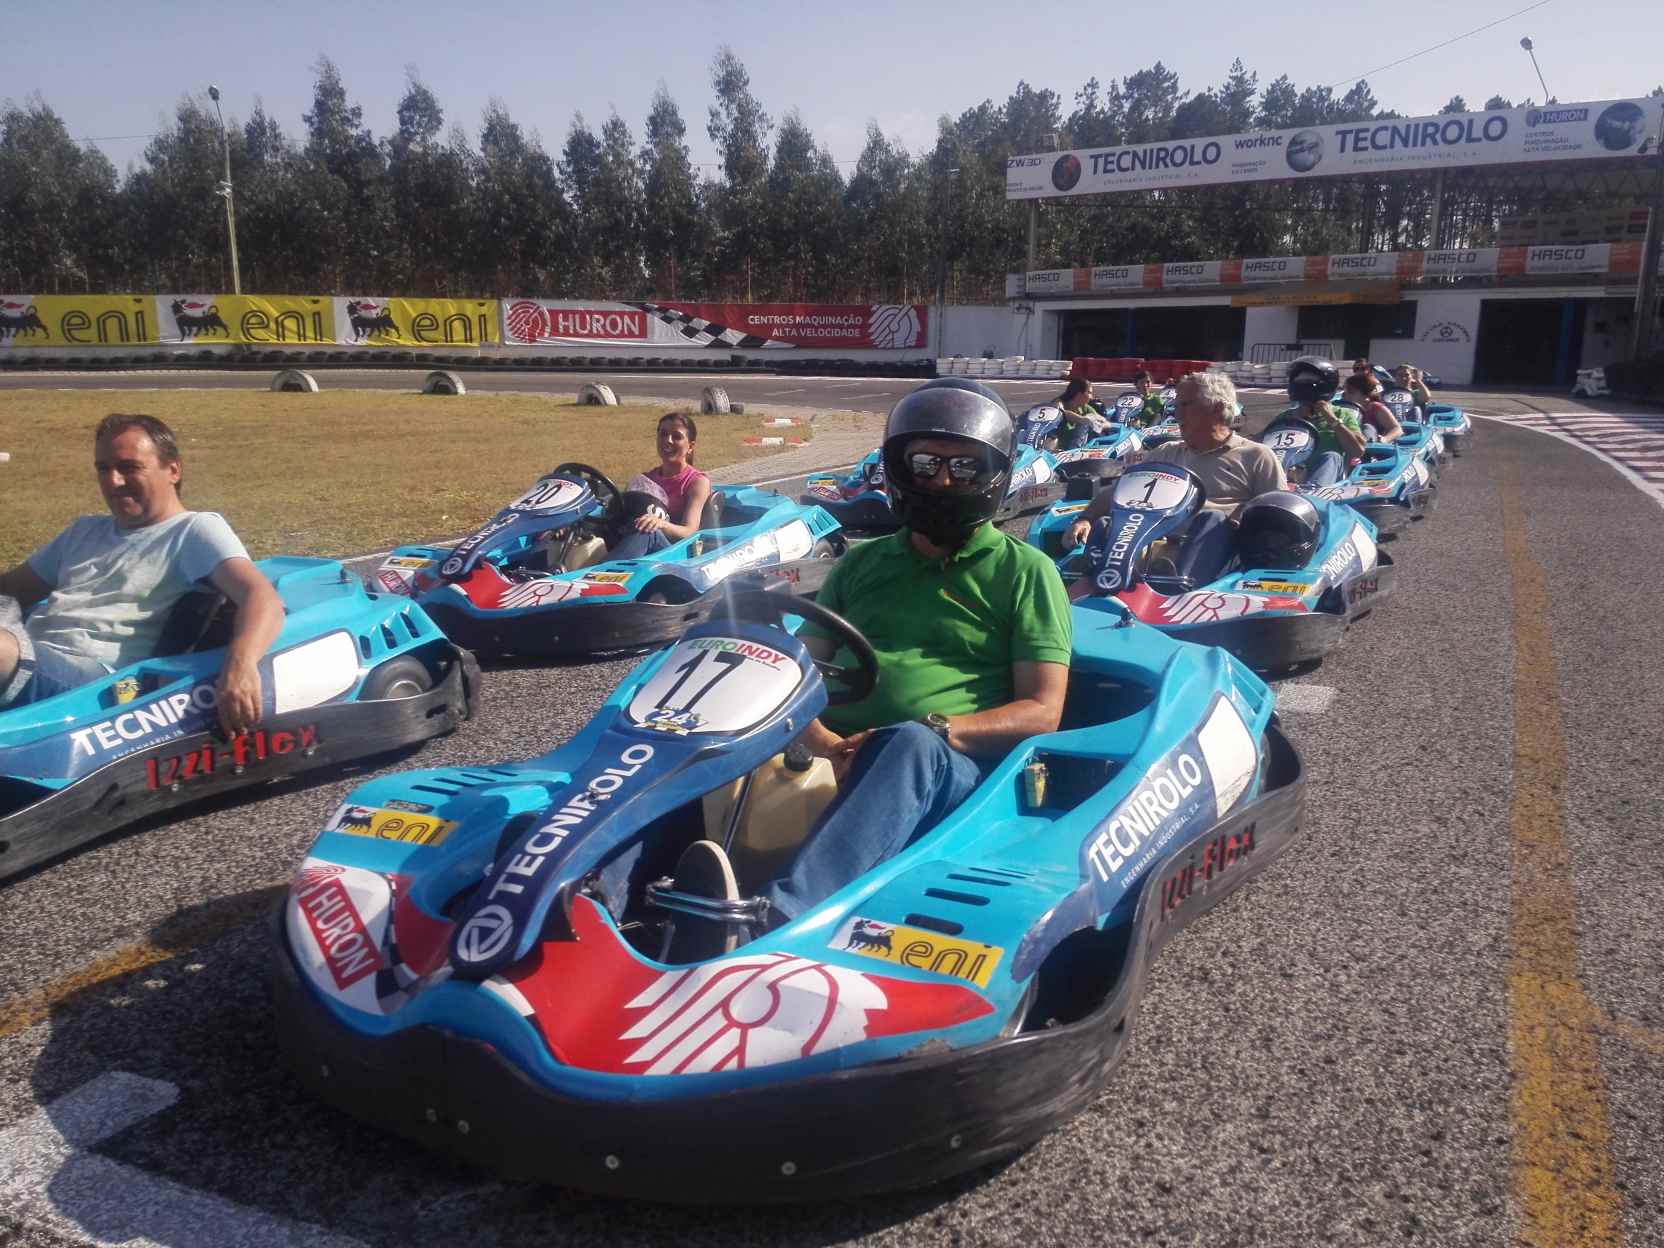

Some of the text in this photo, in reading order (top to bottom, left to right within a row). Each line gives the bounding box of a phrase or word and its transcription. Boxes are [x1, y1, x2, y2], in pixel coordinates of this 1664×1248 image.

[1334, 115, 1508, 153] TECNIROLO
[1089, 141, 1221, 176] TECNIROLO
[1245, 260, 1287, 272] HASCO
[1331, 255, 1377, 268] HASCO
[1427, 252, 1477, 265] HASCO
[1531, 248, 1585, 261] HASCO
[1028, 272, 1059, 282] HASCO
[1094, 269, 1128, 279] HASCO
[1166, 265, 1204, 275] HASCO
[60, 298, 146, 343] eni
[240, 298, 325, 343] eni
[411, 302, 487, 343] eni
[557, 312, 640, 336] HURON
[747, 313, 863, 326] CENTROS MAQUINAÇÃO
[771, 328, 861, 337] ALTA VELOCIDADE
[1038, 408, 1047, 419] 5
[1274, 432, 1296, 448] 15
[1143, 478, 1159, 503] 1
[1105, 513, 1145, 568] TECNIROLO
[654, 649, 748, 714] 17
[70, 684, 218, 756] TECNIRO
[488, 743, 655, 900] TECNIROLO
[1088, 753, 1202, 882] TECNIROLO
[376, 817, 449, 845] eni
[308, 886, 375, 979] HURON
[901, 940, 993, 982] eni
